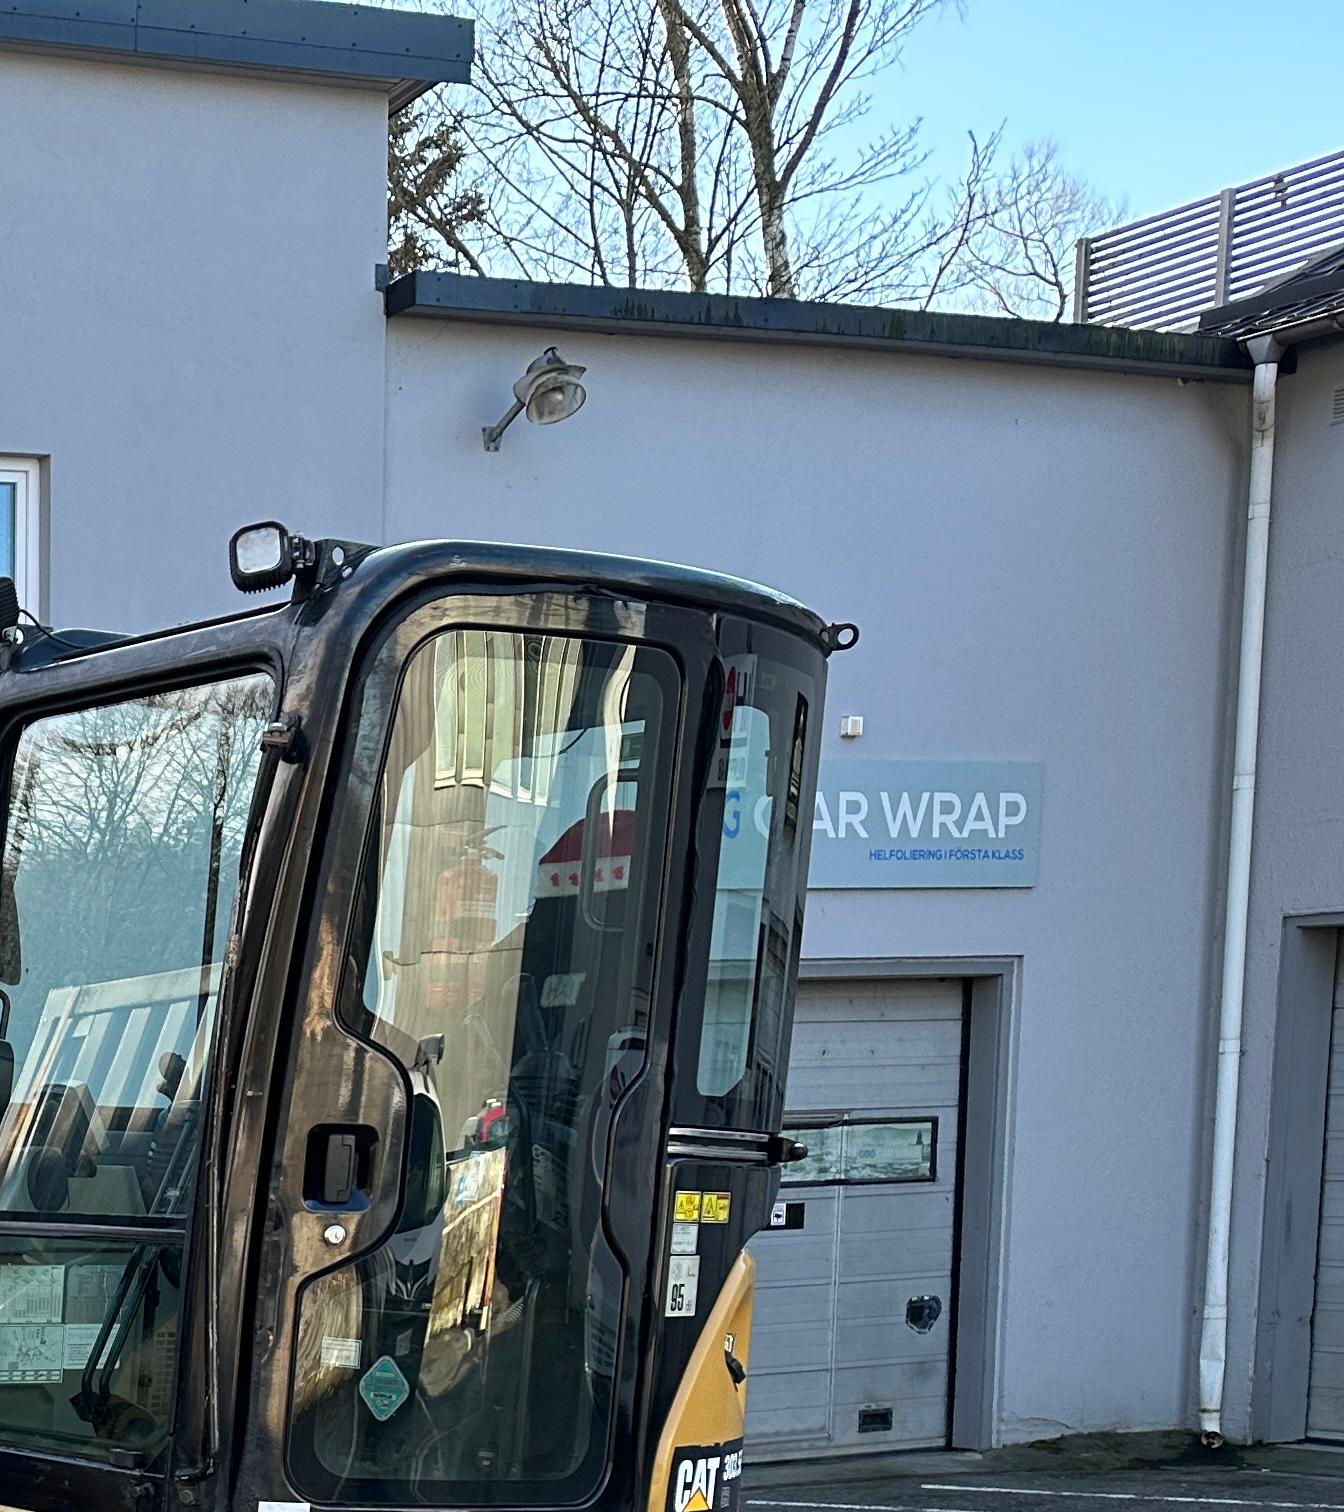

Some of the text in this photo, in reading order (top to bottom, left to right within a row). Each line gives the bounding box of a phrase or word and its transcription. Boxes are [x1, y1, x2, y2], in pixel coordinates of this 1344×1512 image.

[879, 791, 1028, 839] WRAP
[869, 848, 943, 861] HELFOLIERING
[948, 846, 990, 861] FÖRSTA
[991, 848, 1025, 861] KLASS
[670, 1283, 686, 1312] 95
